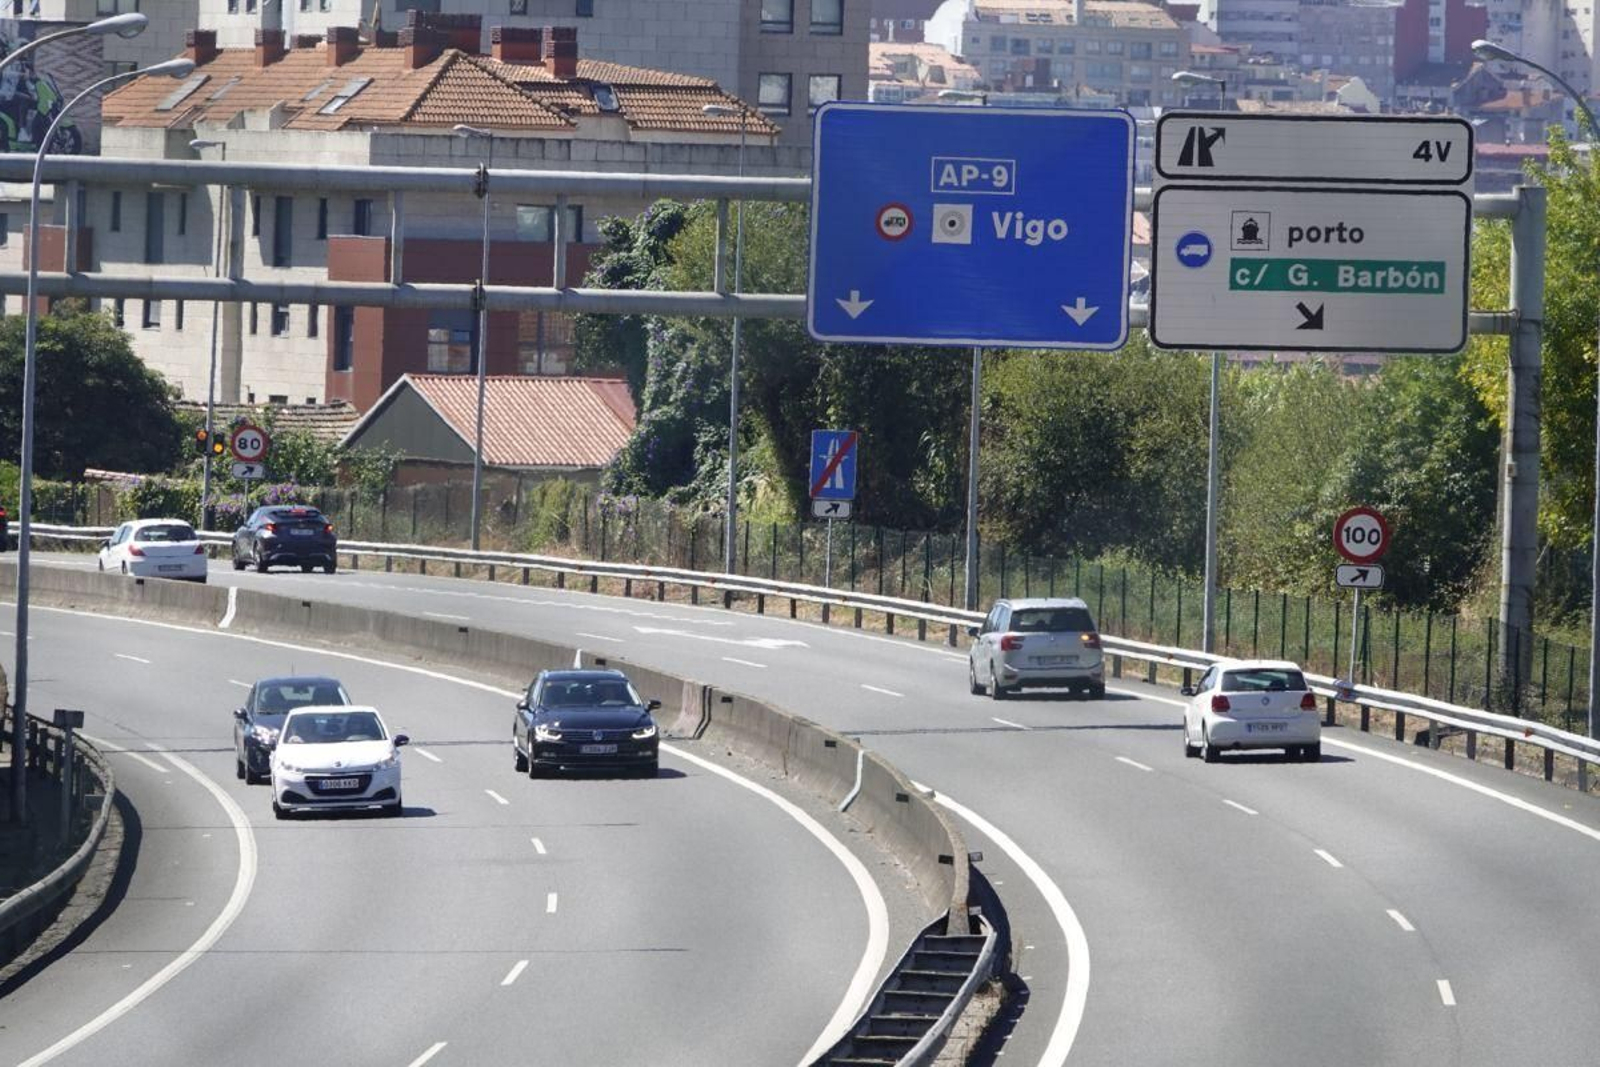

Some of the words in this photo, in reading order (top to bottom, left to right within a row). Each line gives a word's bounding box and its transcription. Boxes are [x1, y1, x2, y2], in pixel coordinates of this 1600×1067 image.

[1412, 140, 1452, 163] 4V
[938, 163, 1009, 188] AP-9
[991, 211, 1069, 246] Vigo
[1287, 222, 1365, 248] porto
[1235, 263, 1269, 286] c/
[1287, 263, 1319, 287] G.
[1337, 265, 1440, 289] Barbón
[238, 437, 261, 450] 80
[1344, 526, 1381, 546] 100
